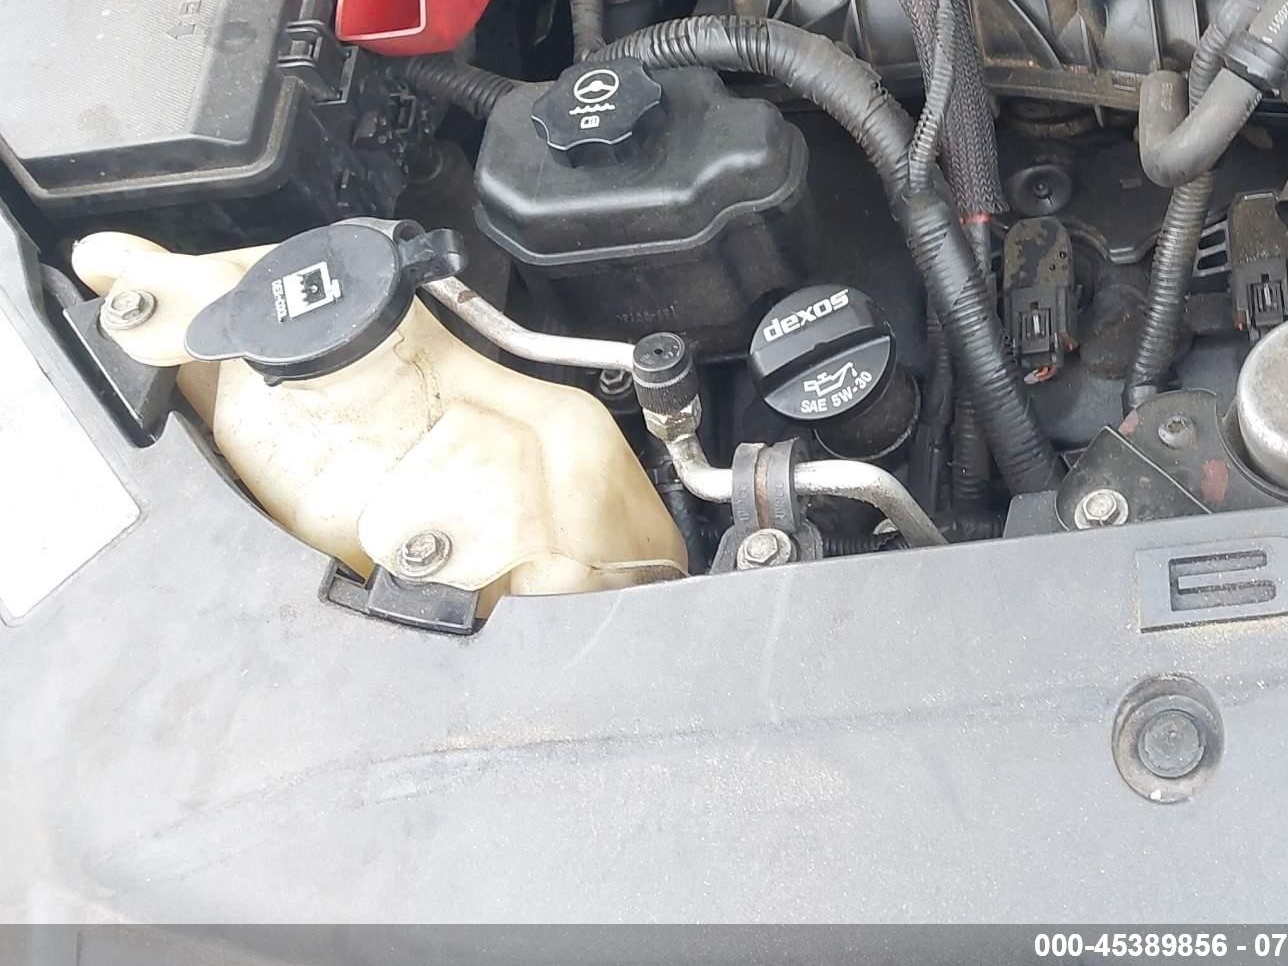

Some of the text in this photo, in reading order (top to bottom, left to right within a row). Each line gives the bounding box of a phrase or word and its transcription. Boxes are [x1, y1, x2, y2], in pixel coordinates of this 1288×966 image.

[762, 287, 849, 342] dexos
[799, 370, 872, 413] SAE 5W-30
